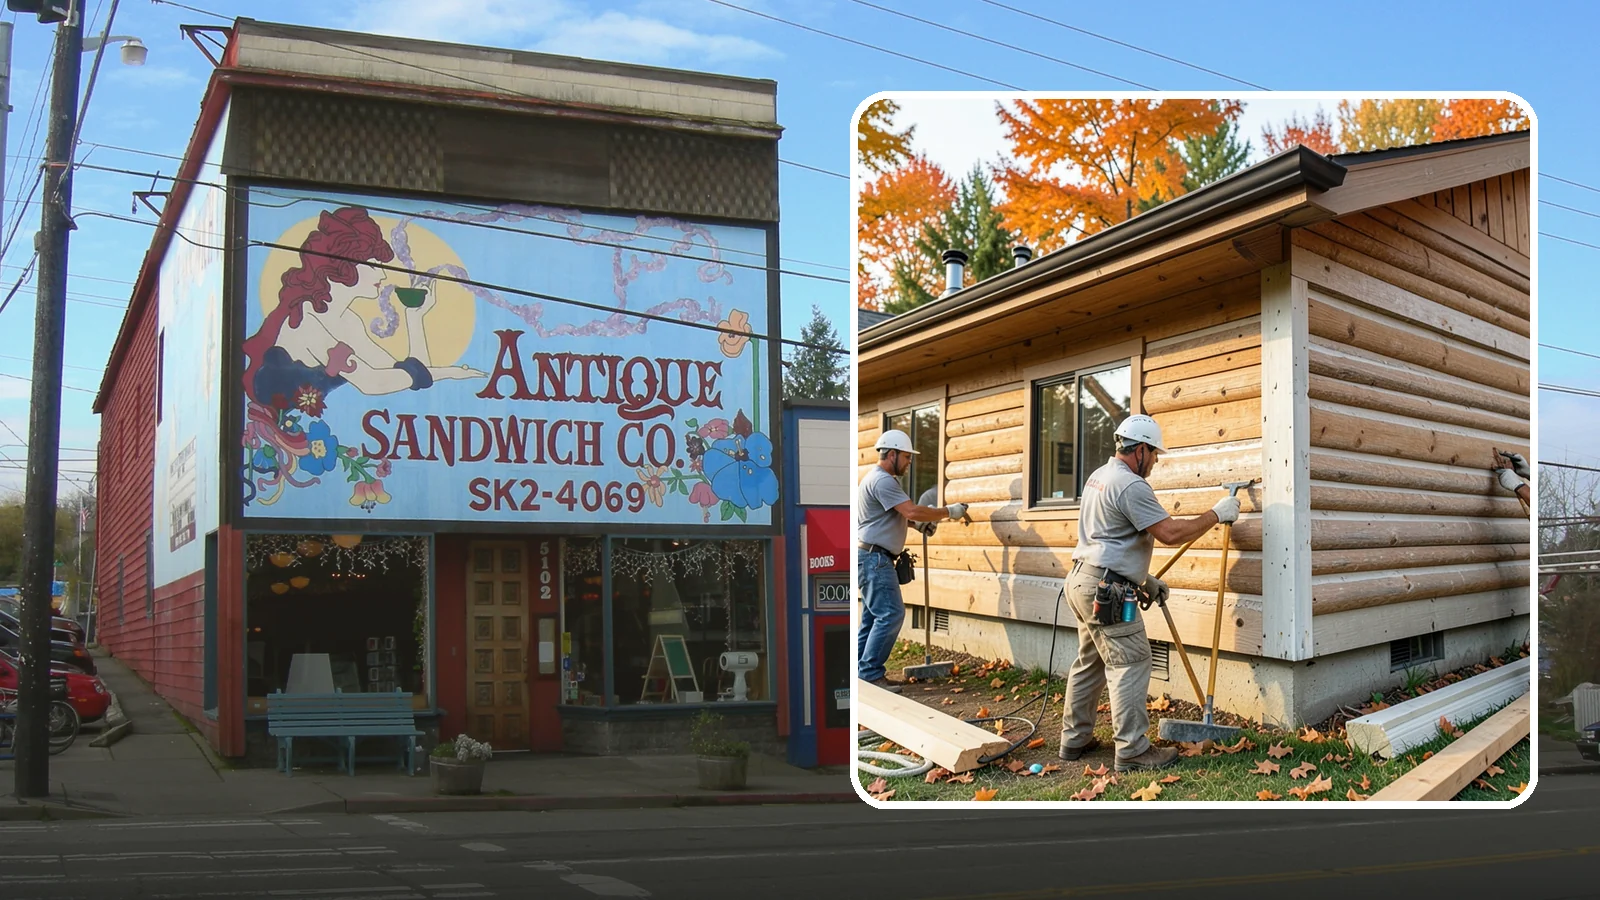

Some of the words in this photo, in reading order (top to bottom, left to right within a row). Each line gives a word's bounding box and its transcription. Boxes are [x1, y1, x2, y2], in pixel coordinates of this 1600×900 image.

[475, 328, 724, 422] ANTIQUE
[361, 408, 605, 469] SANDWICH
[616, 421, 685, 469] CO.
[468, 477, 646, 513] SK2-4069
[540, 541, 551, 600] 5102
[809, 555, 835, 569] BOOKS
